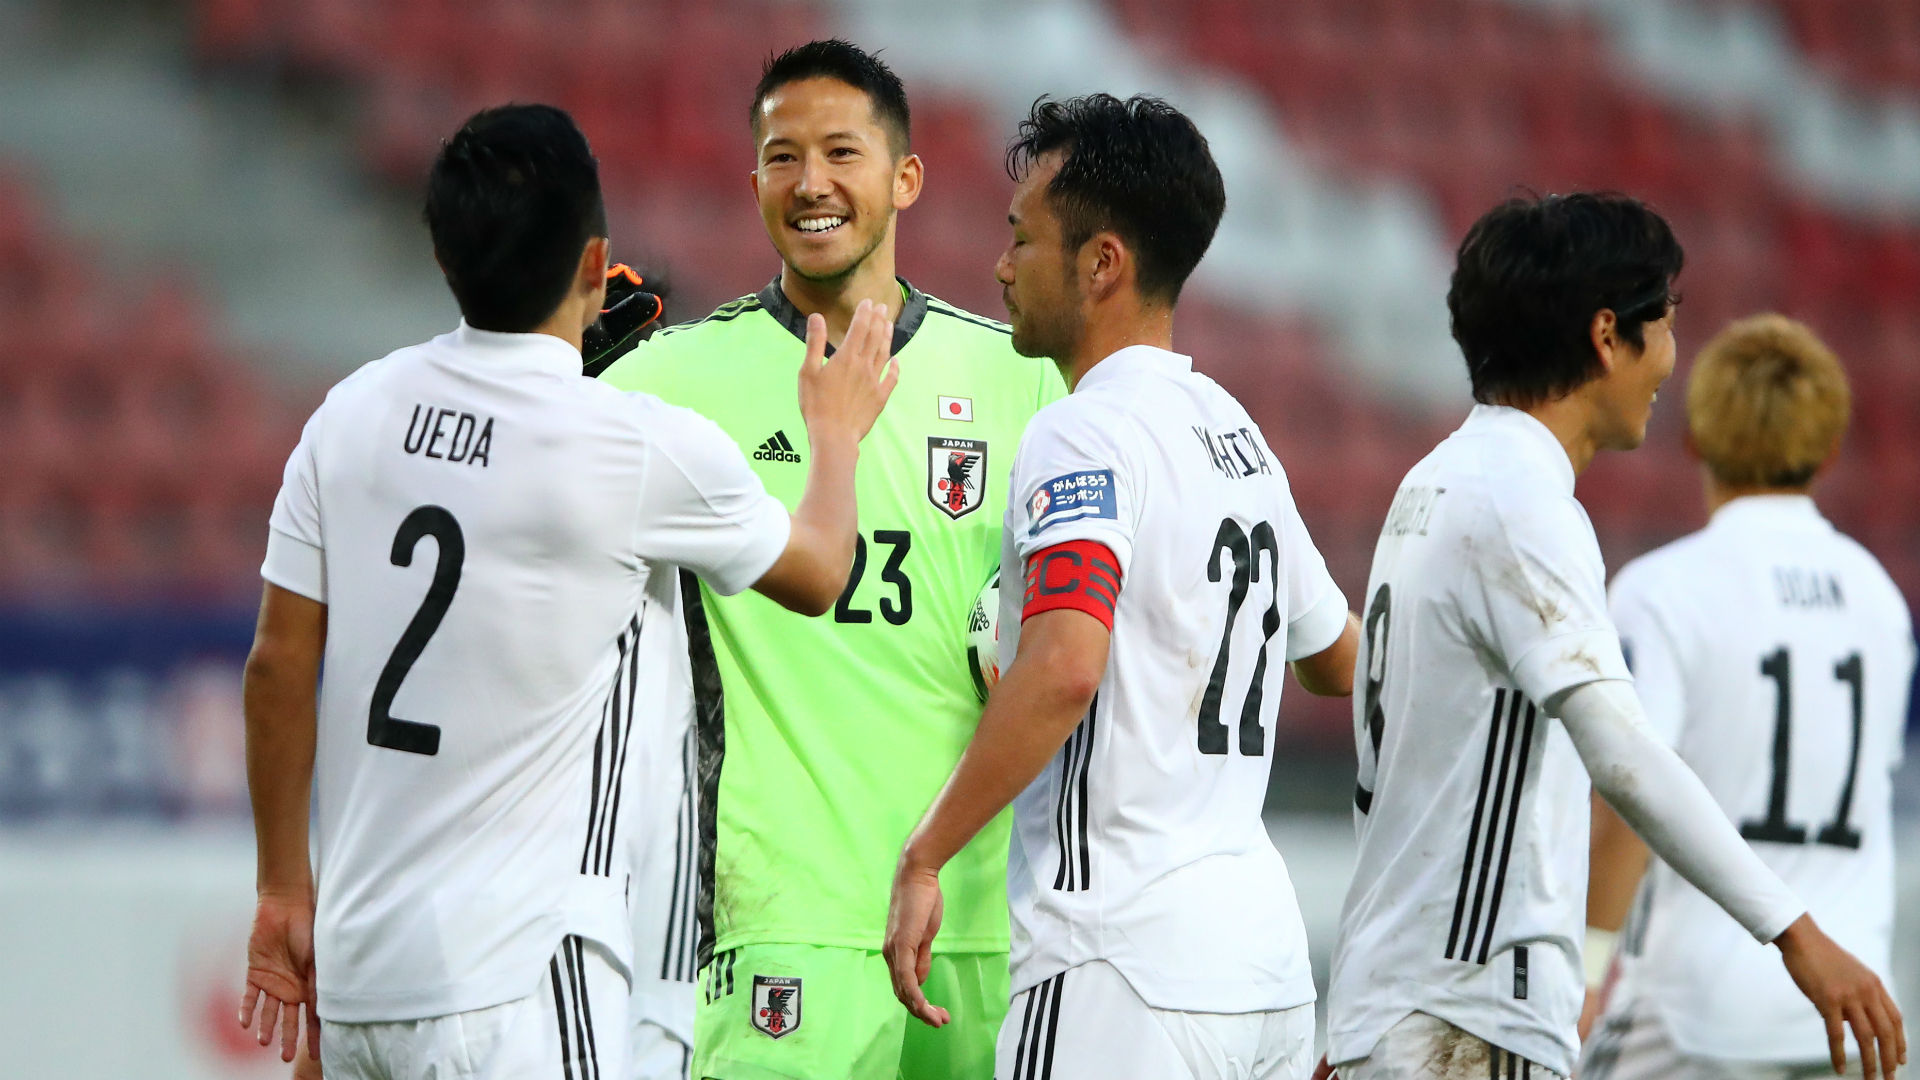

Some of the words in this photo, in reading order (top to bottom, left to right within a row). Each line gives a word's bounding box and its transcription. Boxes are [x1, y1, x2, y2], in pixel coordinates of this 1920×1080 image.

[403, 403, 495, 468] UEDA
[941, 439, 975, 449] JAPAN
[753, 449, 801, 464] adidas
[1052, 474, 1109, 493] がんばろう
[942, 492, 969, 507] JFA
[834, 529, 913, 626] 23
[1038, 550, 1082, 594] C
[367, 504, 465, 756] 2
[1197, 516, 1281, 757] 22
[1740, 644, 1863, 850] 11
[764, 977, 791, 985] JAPAN
[764, 1017, 787, 1028] JFA
